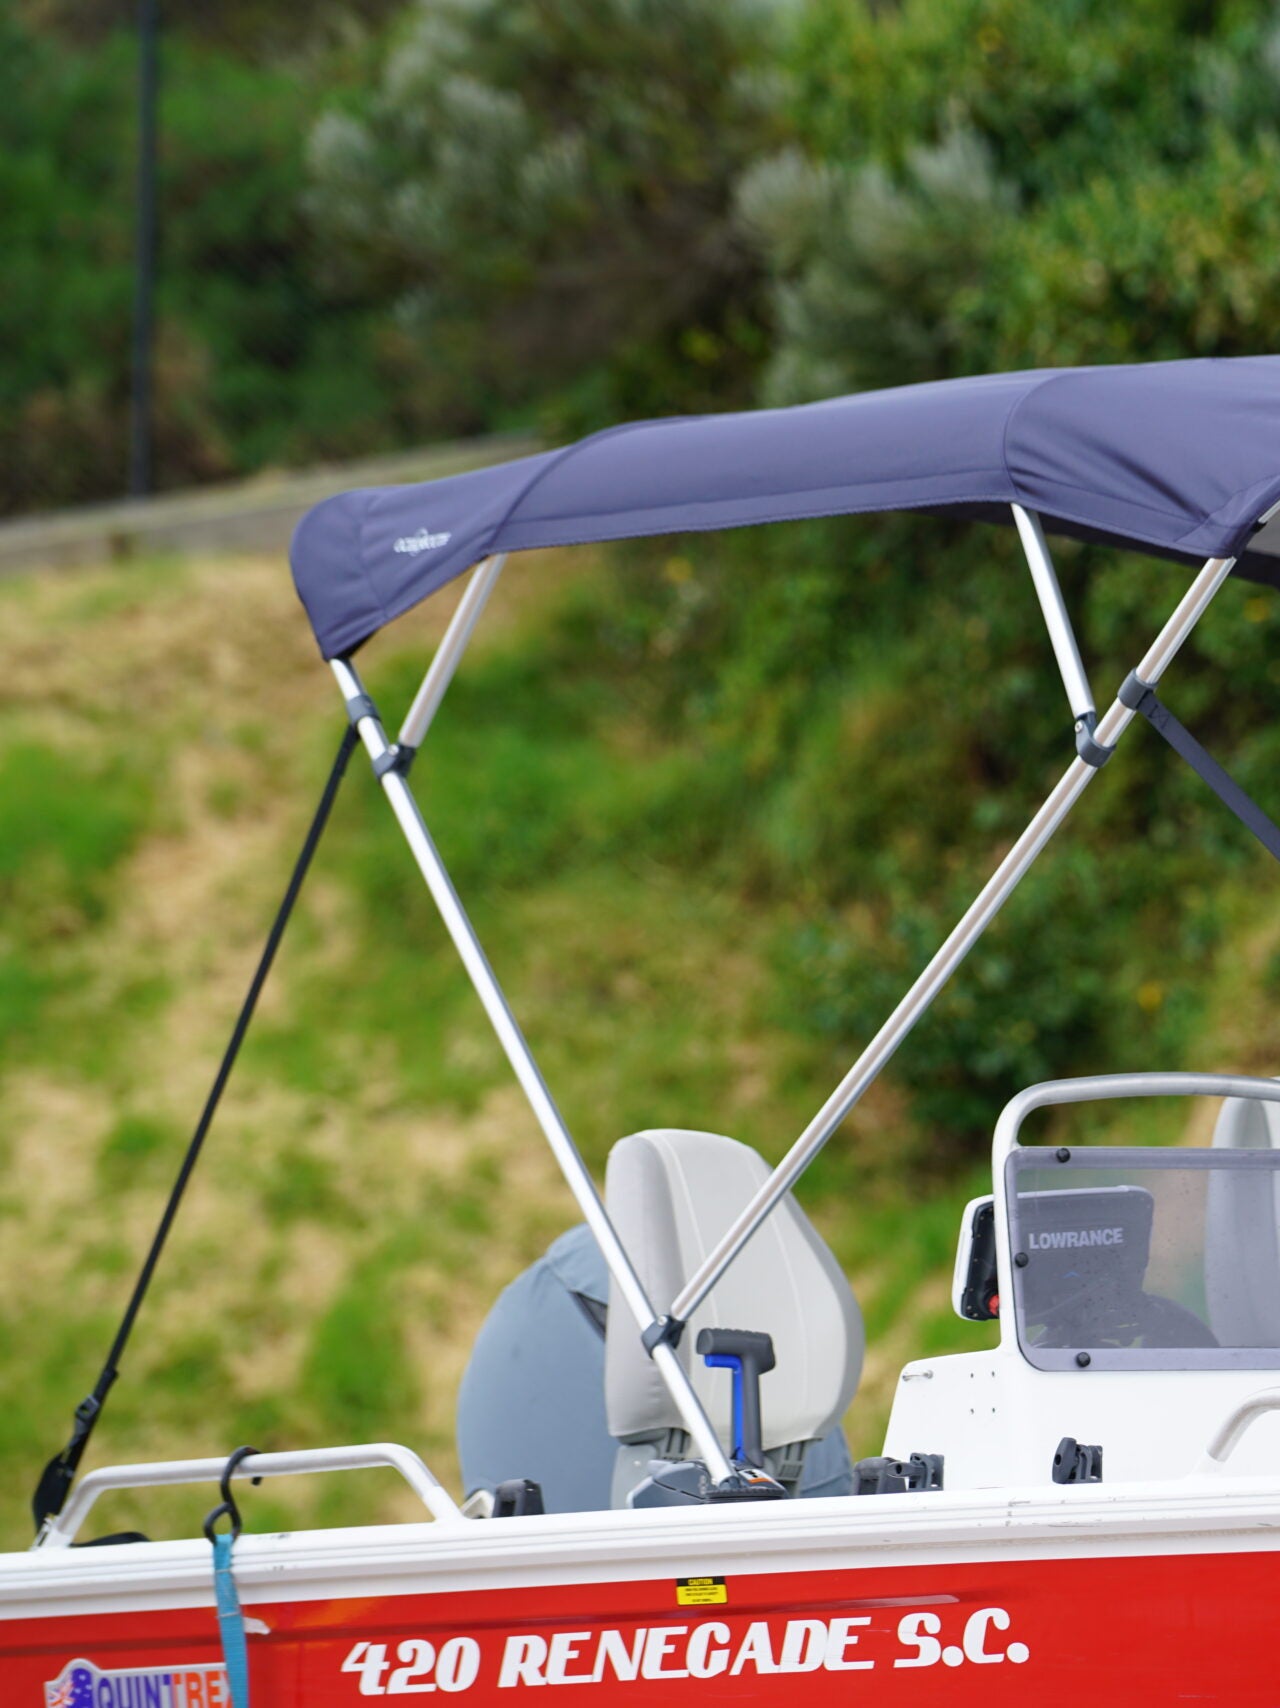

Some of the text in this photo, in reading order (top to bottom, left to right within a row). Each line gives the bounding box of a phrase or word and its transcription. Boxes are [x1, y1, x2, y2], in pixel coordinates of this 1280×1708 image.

[1029, 1228, 1123, 1249] LOWRANCE
[341, 1607, 1030, 1696] 420 RENEGADE S.C.
